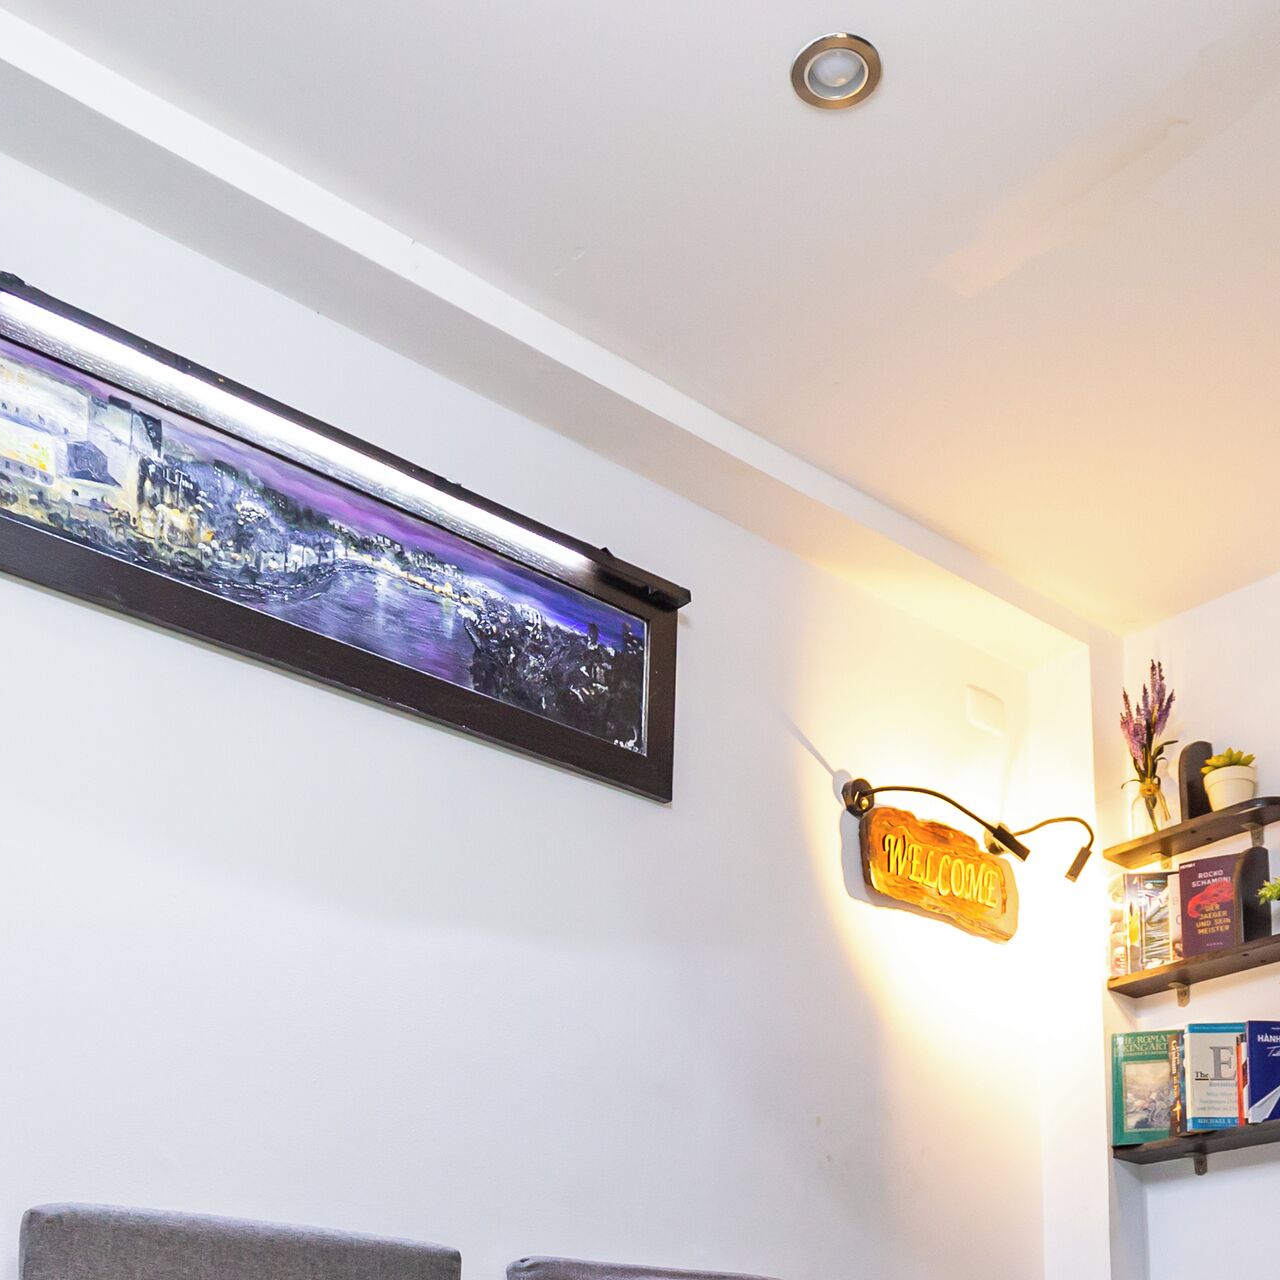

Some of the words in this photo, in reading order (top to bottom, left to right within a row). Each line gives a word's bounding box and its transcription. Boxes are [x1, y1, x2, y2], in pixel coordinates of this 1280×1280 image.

[883, 833, 999, 908] WELCOME
[1198, 869, 1224, 879] ROCKO
[1191, 876, 1232, 888] SCHAMONI
[1197, 924, 1231, 935] MEISTER
[1139, 1034, 1169, 1044] ROMA
[1195, 1071, 1209, 1079] The
